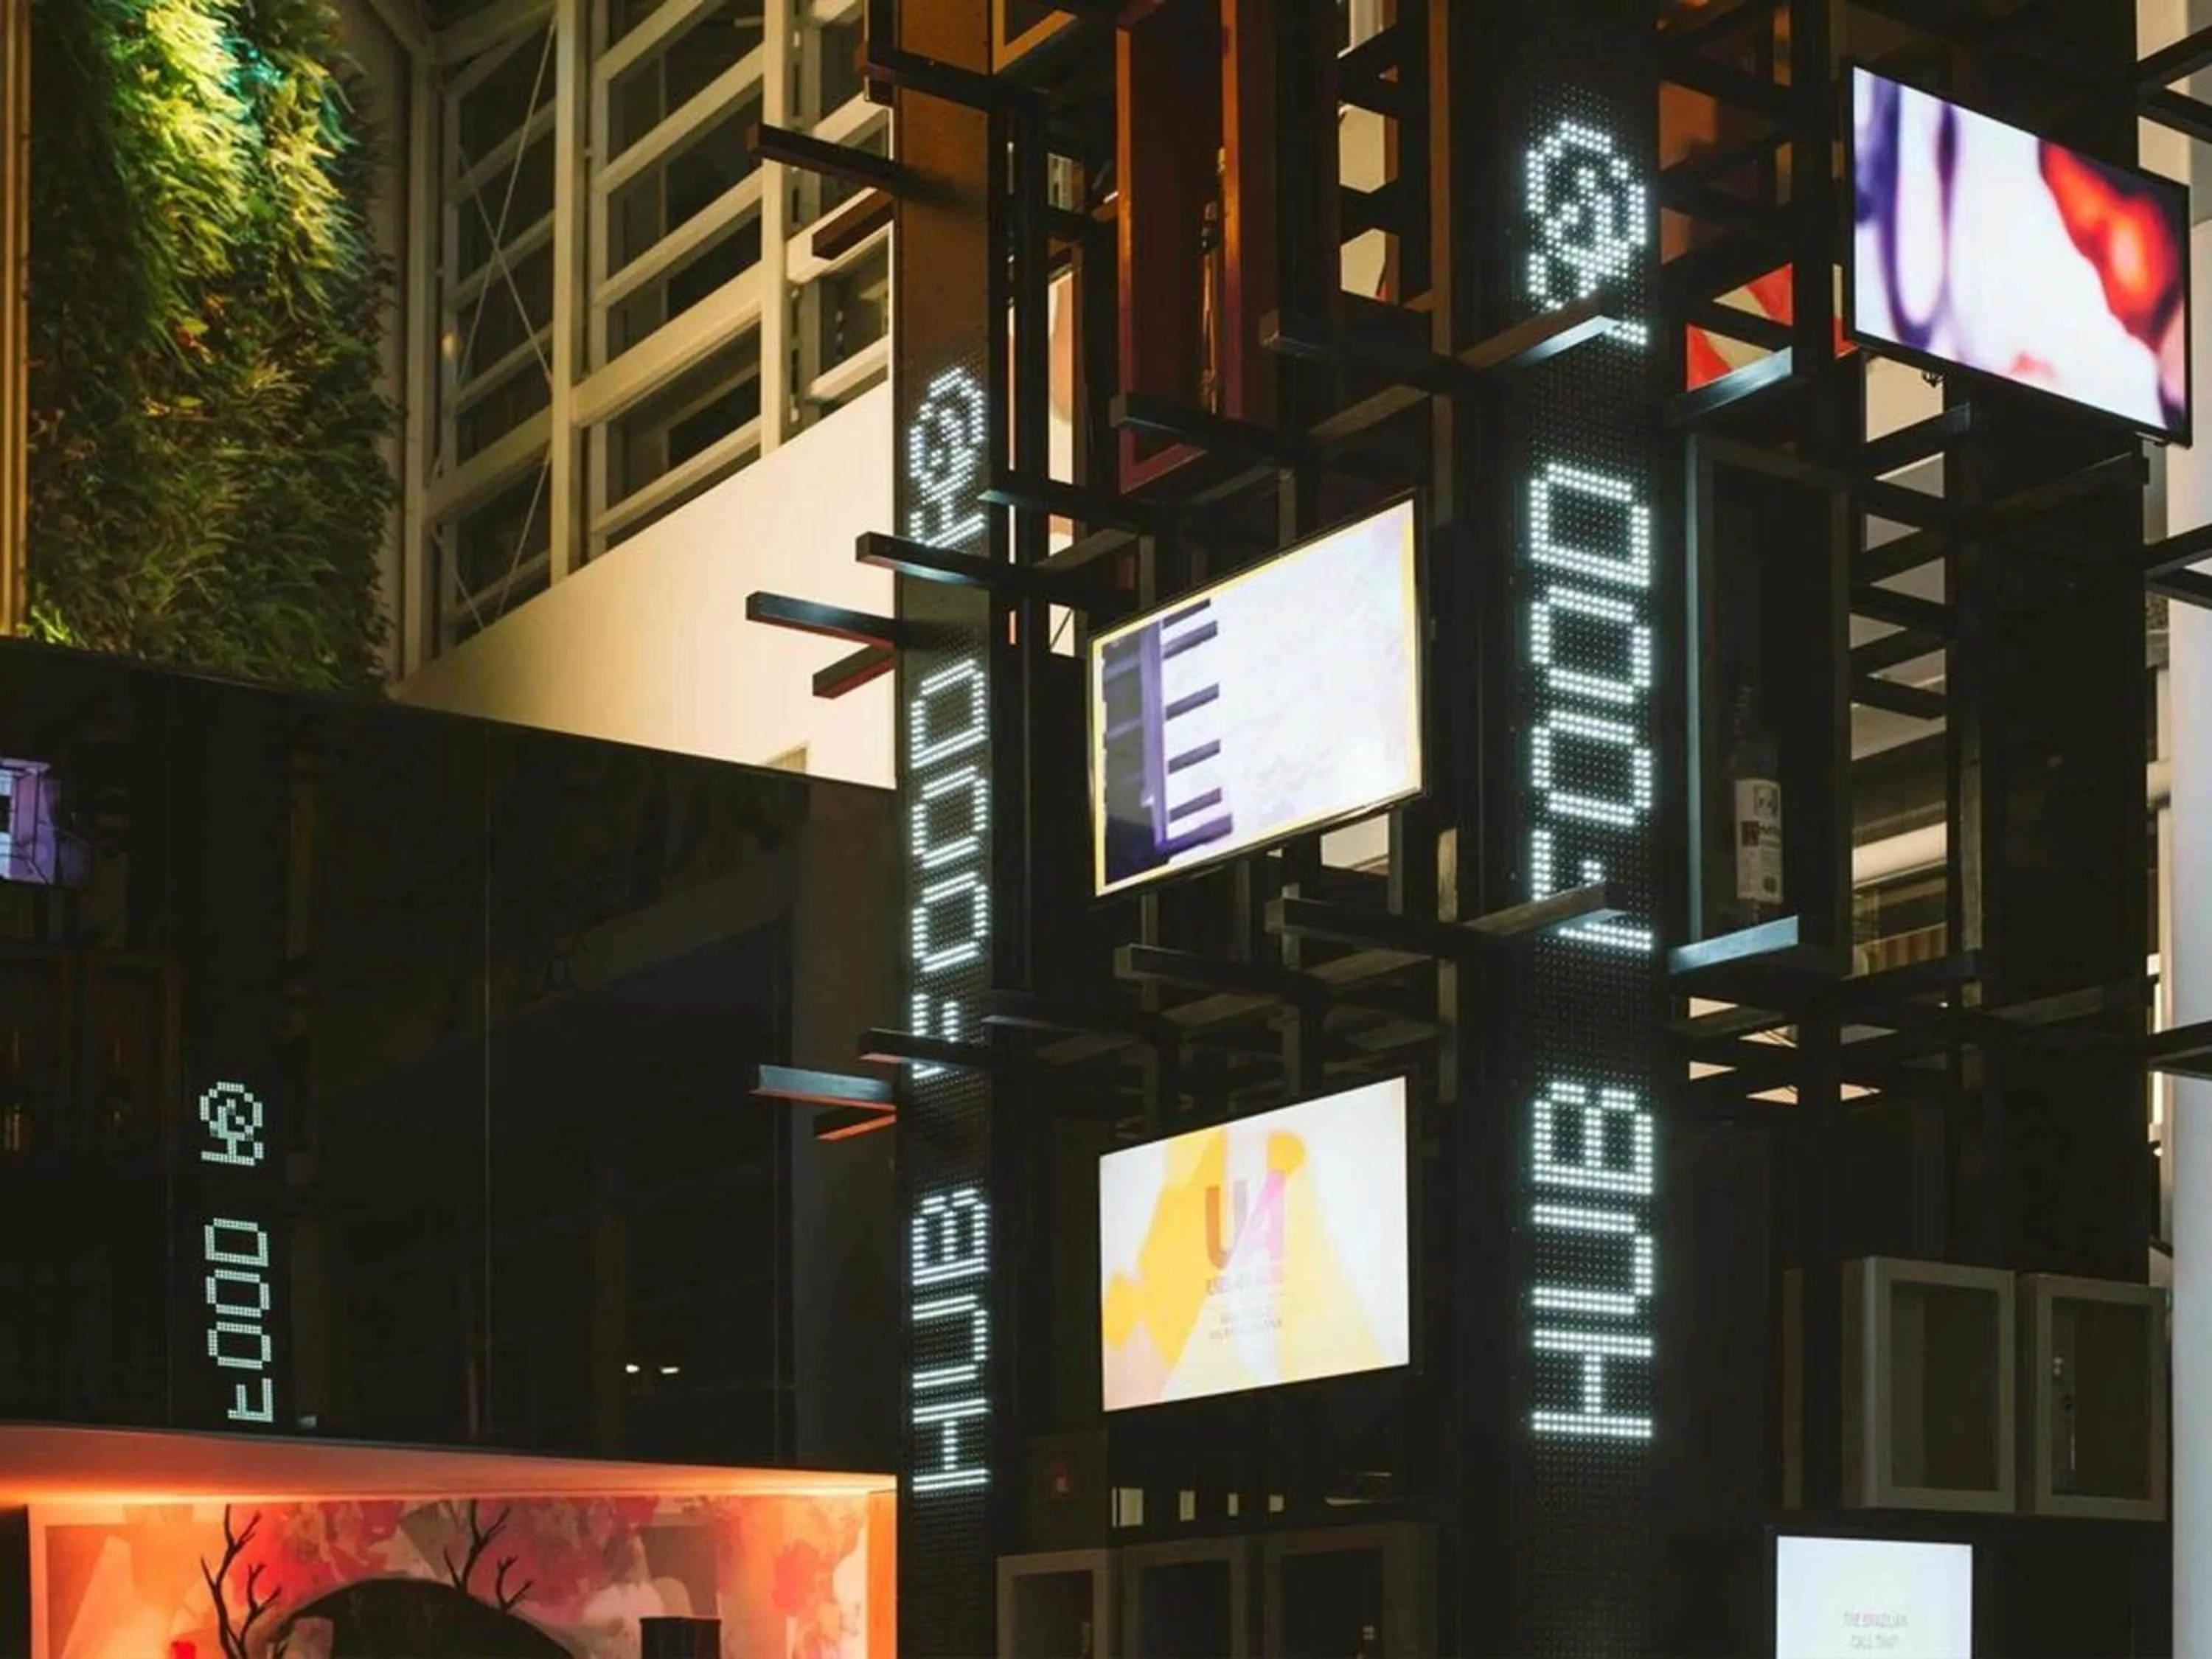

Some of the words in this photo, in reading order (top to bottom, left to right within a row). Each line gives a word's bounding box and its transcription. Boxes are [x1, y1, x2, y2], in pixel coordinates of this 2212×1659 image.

[1529, 462, 1652, 951] FOOD
[911, 1187, 990, 1492] HUB
[1531, 1081, 1653, 1439] HUB
